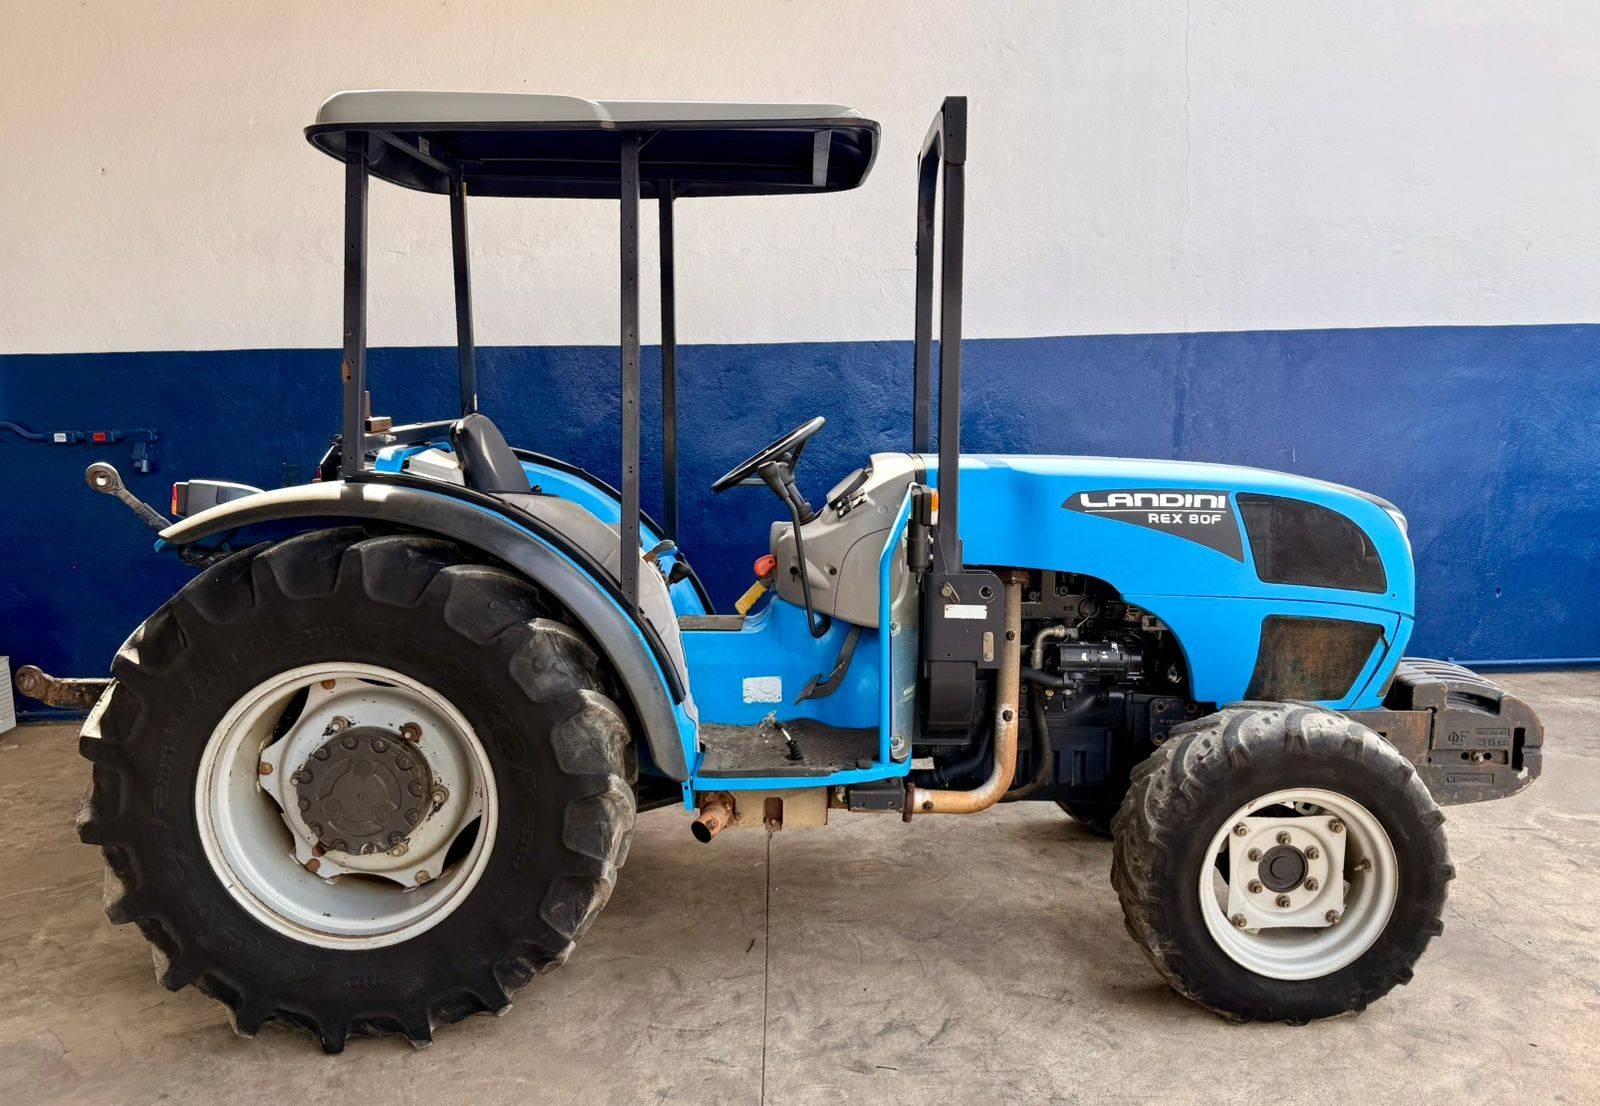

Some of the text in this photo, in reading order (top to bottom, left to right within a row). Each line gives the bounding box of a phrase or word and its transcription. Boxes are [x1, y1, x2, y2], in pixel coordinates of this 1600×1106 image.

[1080, 493, 1226, 508] LANDINI
[1148, 513, 1222, 525] REX 80F
